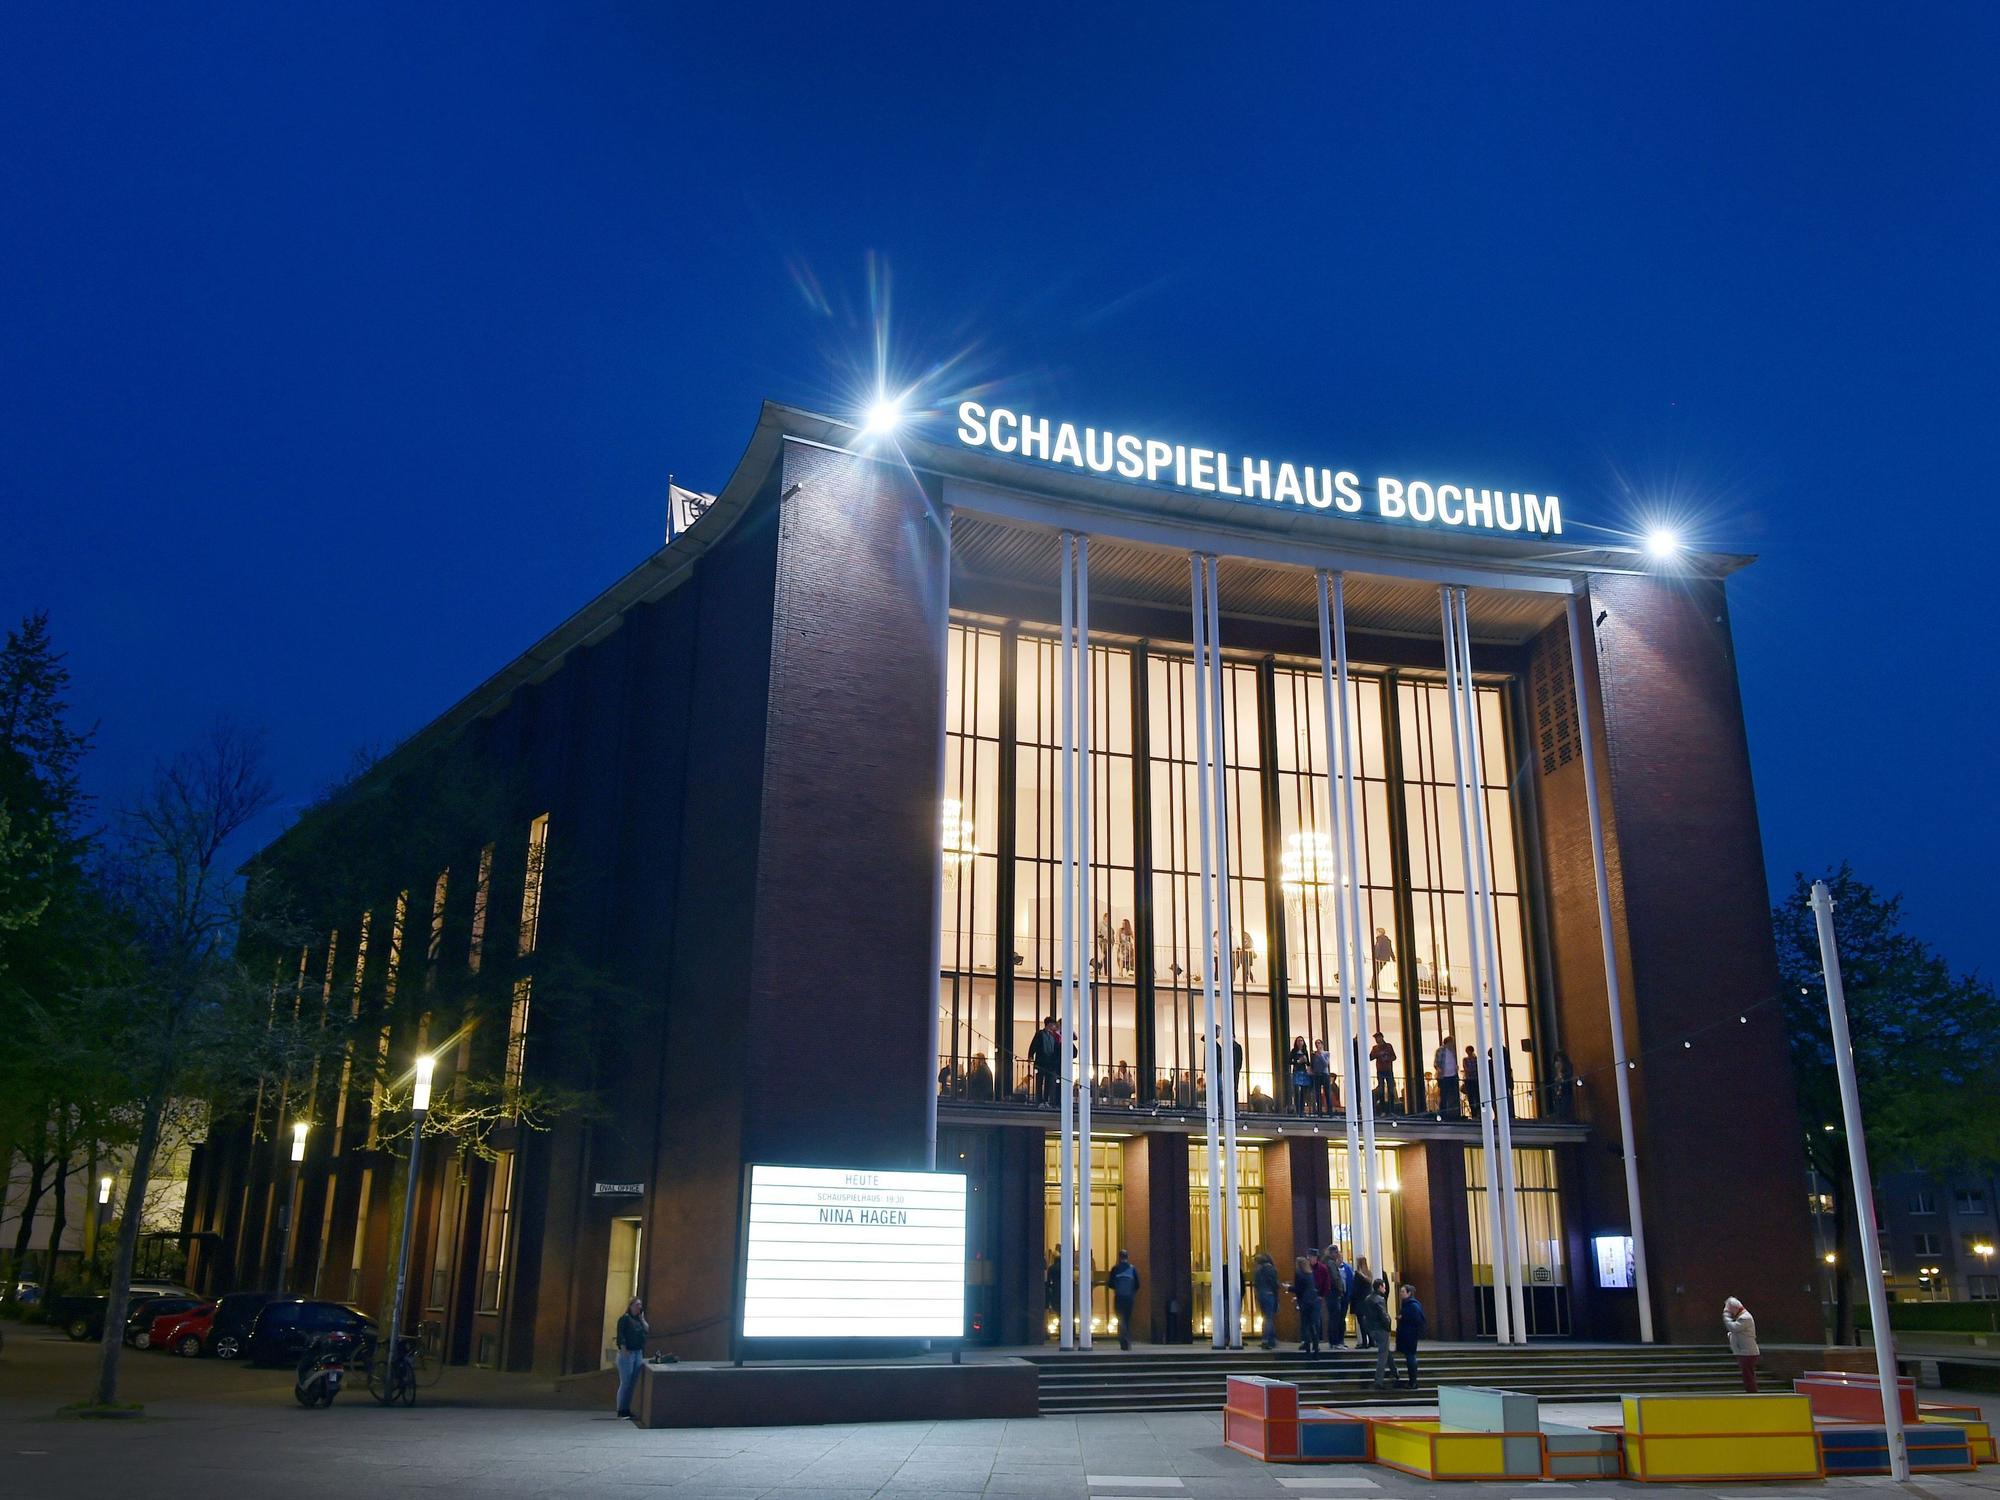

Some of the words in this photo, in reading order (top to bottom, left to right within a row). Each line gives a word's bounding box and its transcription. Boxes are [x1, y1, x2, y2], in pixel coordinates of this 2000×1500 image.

[957, 401, 1363, 513] SCHAUSPIELHAUS
[1377, 476, 1563, 535] BOCHUM
[845, 1174, 879, 1186] HEUTE
[819, 1208, 854, 1223] NINA
[860, 1210, 907, 1225] HAGEN
